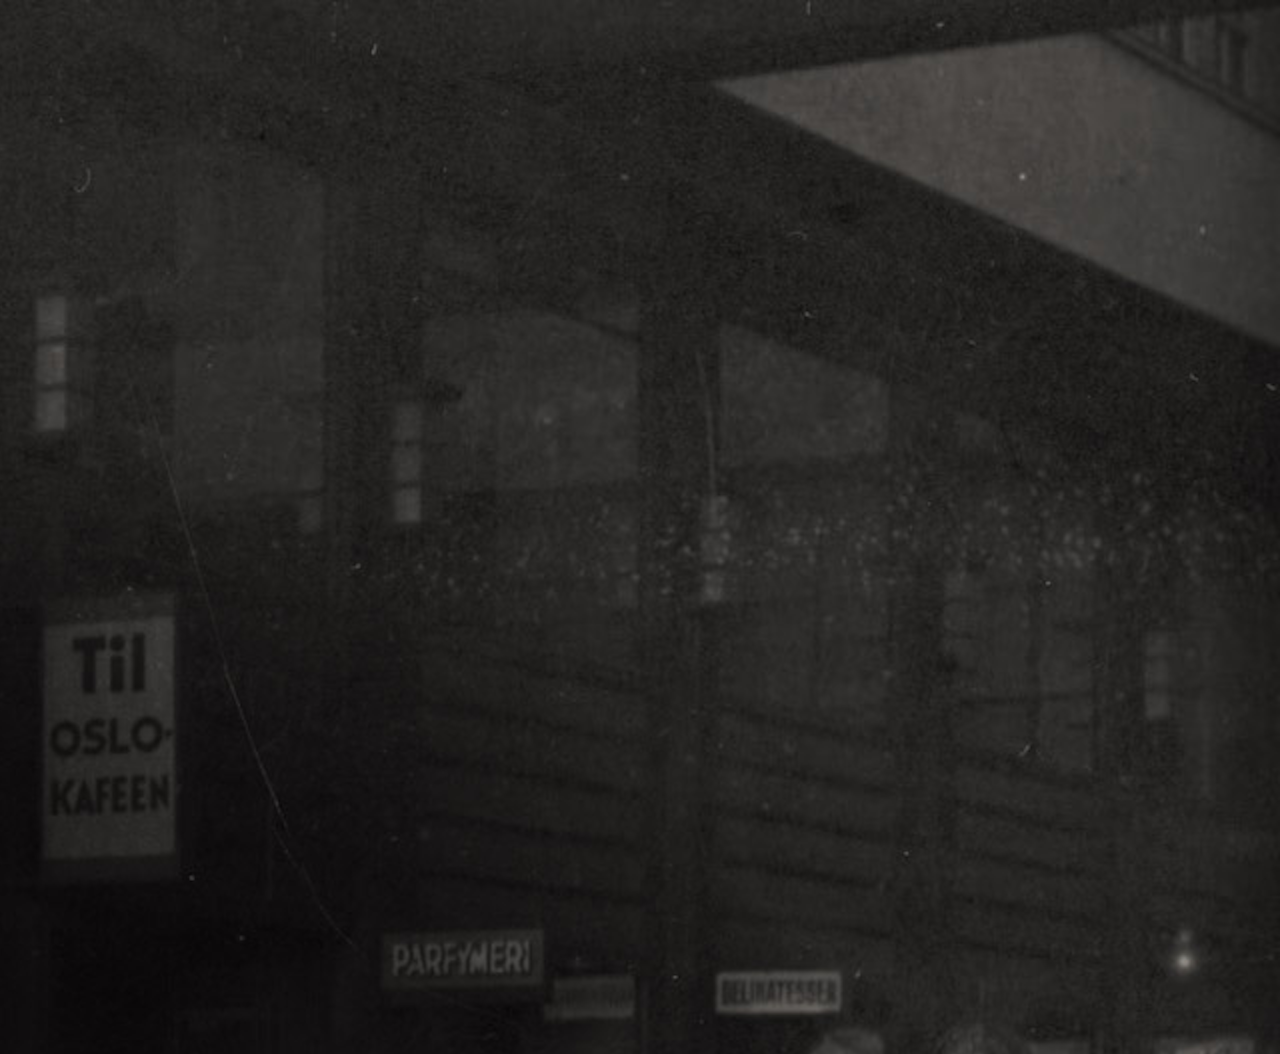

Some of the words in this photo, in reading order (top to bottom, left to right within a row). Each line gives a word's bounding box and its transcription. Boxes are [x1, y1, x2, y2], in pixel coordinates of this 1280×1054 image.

[73, 634, 146, 694] Til
[51, 718, 171, 757] OSLO-
[51, 774, 171, 816] KAFEEN
[391, 940, 530, 977] PARFYMERI
